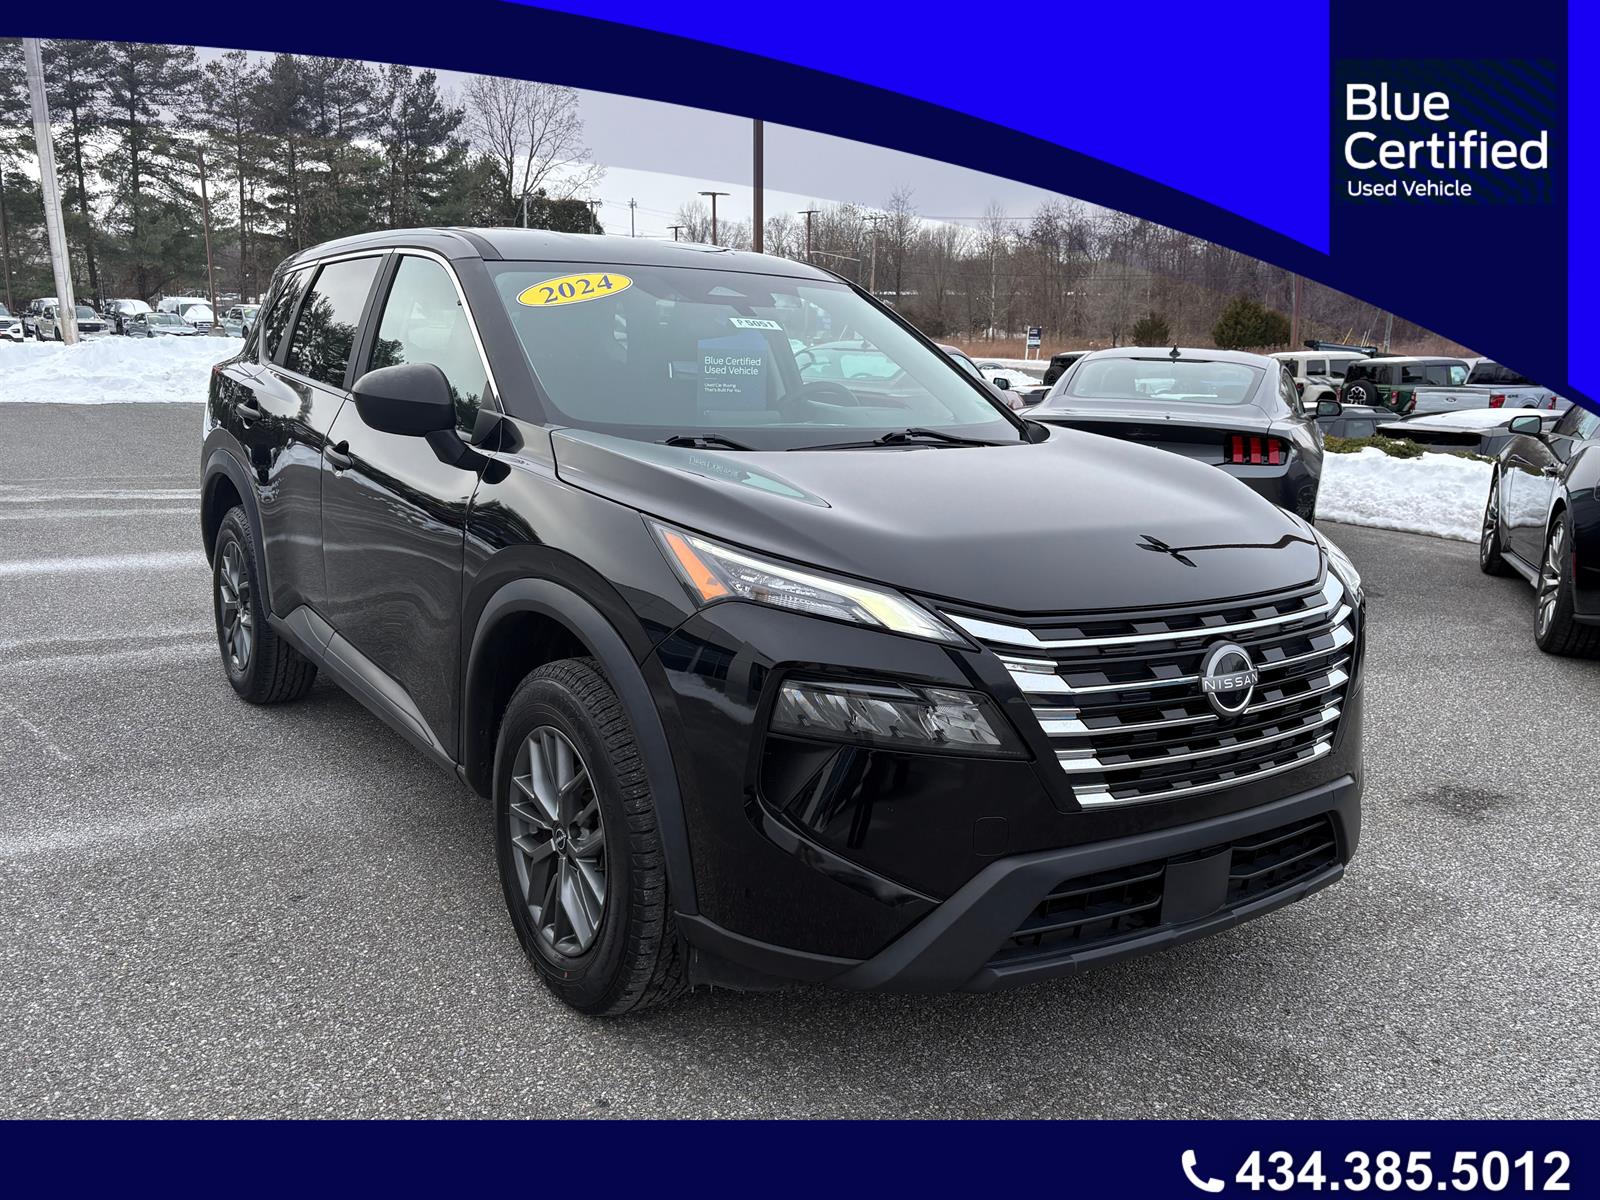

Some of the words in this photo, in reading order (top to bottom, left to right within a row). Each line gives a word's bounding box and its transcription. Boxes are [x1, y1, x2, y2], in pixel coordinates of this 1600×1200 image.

[539, 275, 613, 303] 2024
[704, 356, 724, 365] Blue
[725, 357, 761, 365] Certified
[704, 365, 727, 374] Used
[728, 366, 759, 375] Vehicle
[1204, 673, 1258, 690] NISSAN
